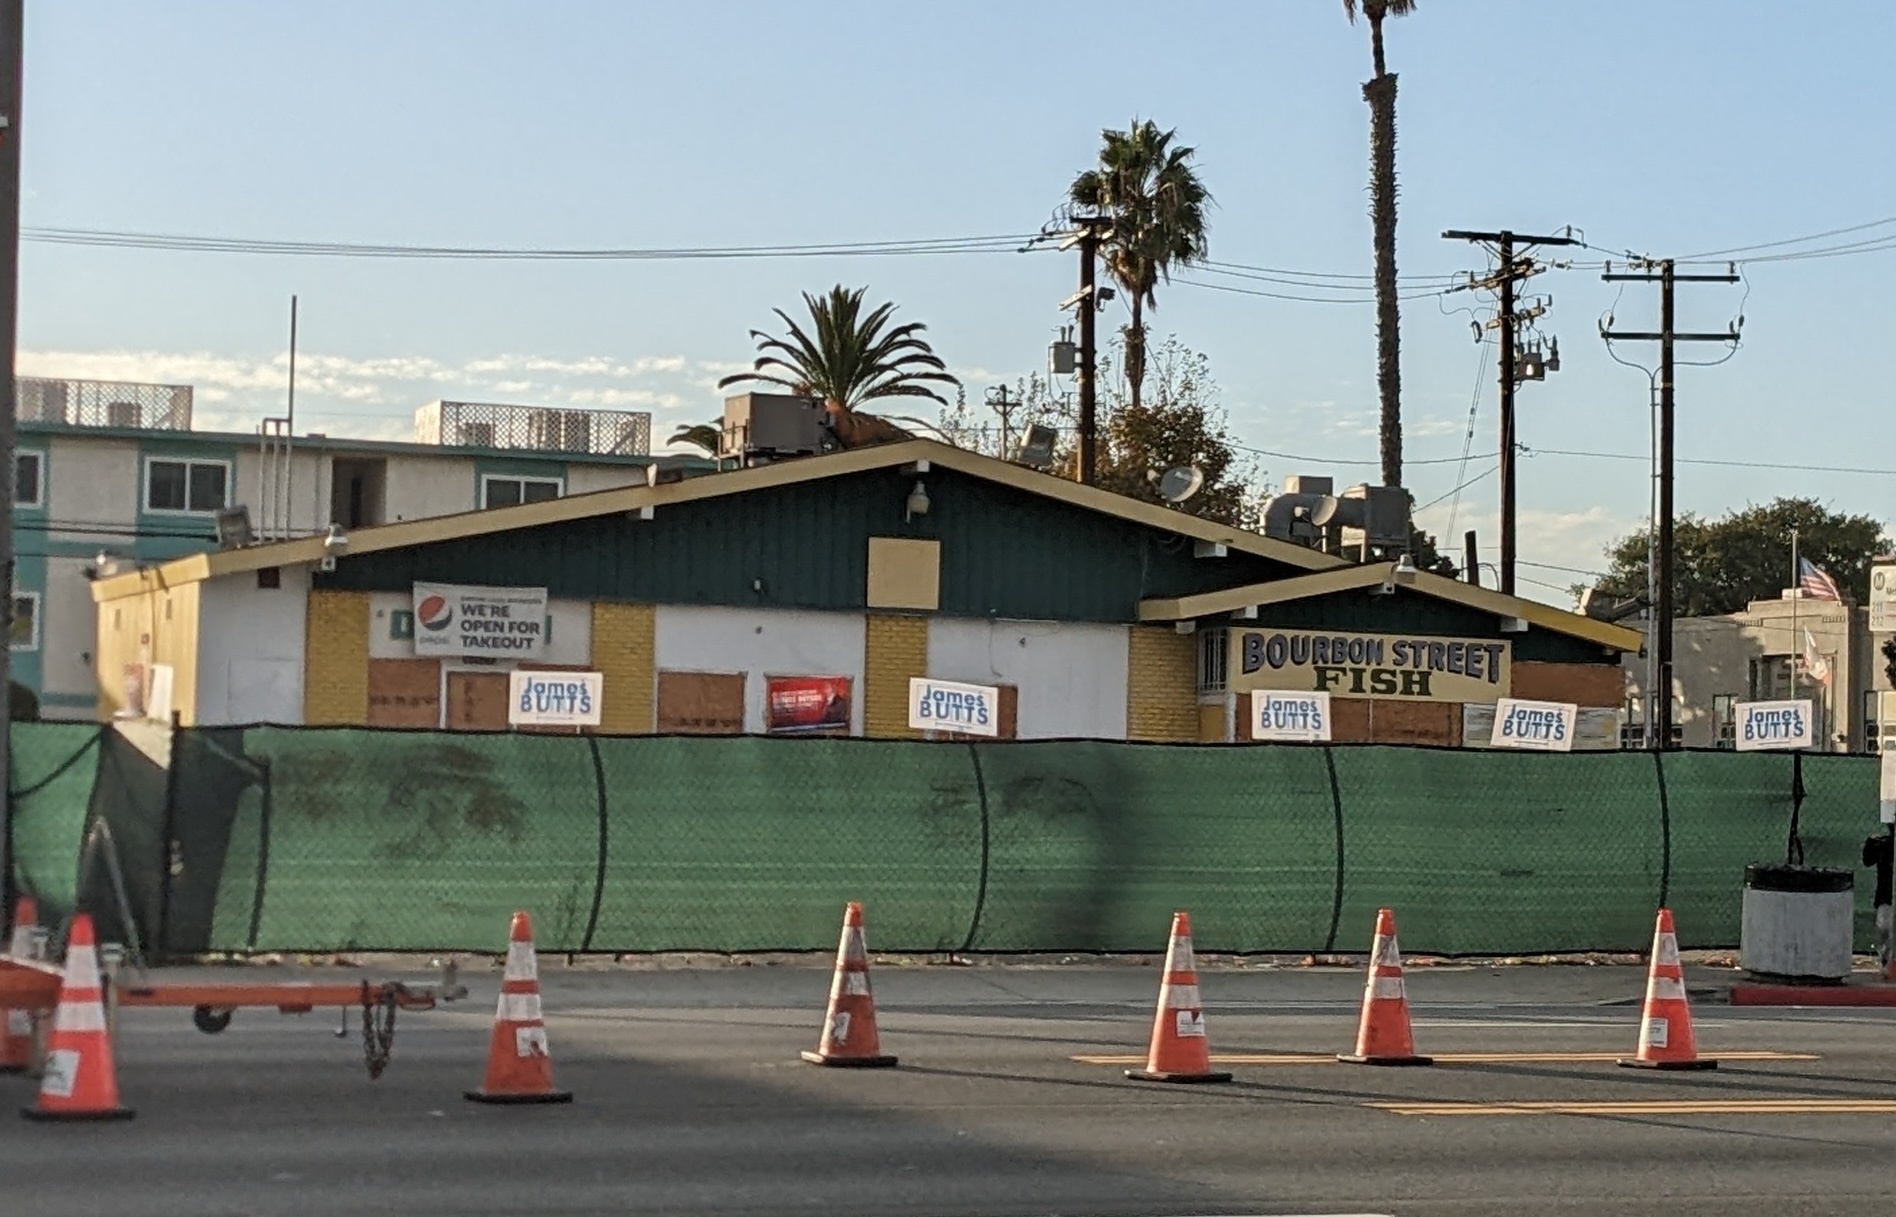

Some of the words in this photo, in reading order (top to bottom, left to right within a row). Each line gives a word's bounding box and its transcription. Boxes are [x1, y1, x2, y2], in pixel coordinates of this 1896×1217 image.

[460, 620, 504, 633] OPEN
[508, 621, 540, 634] FOR
[460, 635, 535, 649] TAKEOUT
[1242, 632, 1384, 675] BOURBON
[1392, 639, 1505, 684] STREET
[523, 676, 588, 694] James
[1313, 665, 1432, 697] FISH
[521, 694, 591, 714] BUTTS
[923, 684, 984, 706] James
[1264, 695, 1318, 712] James
[920, 700, 988, 725] BUTTS
[1261, 711, 1322, 730] BUTTS
[1508, 703, 1563, 723] James
[1747, 707, 1800, 723] James
[1502, 719, 1566, 741] BUTTS
[1744, 721, 1804, 741] BUTTS
